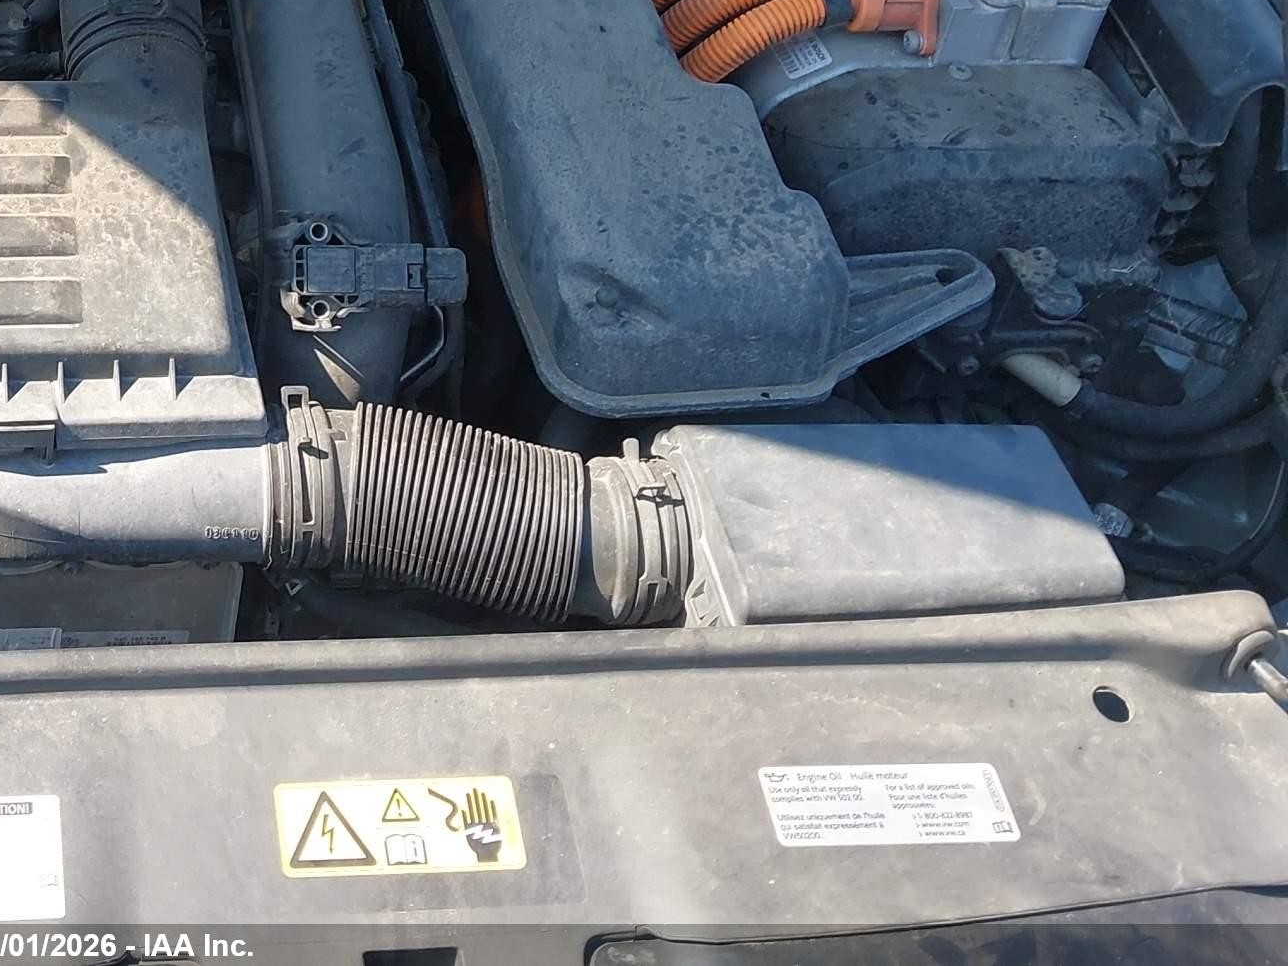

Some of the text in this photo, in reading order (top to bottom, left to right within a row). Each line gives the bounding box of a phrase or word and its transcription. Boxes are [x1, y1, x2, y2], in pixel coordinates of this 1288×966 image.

[797, 772, 842, 783] Engine Oil
[850, 772, 874, 780] Huile
